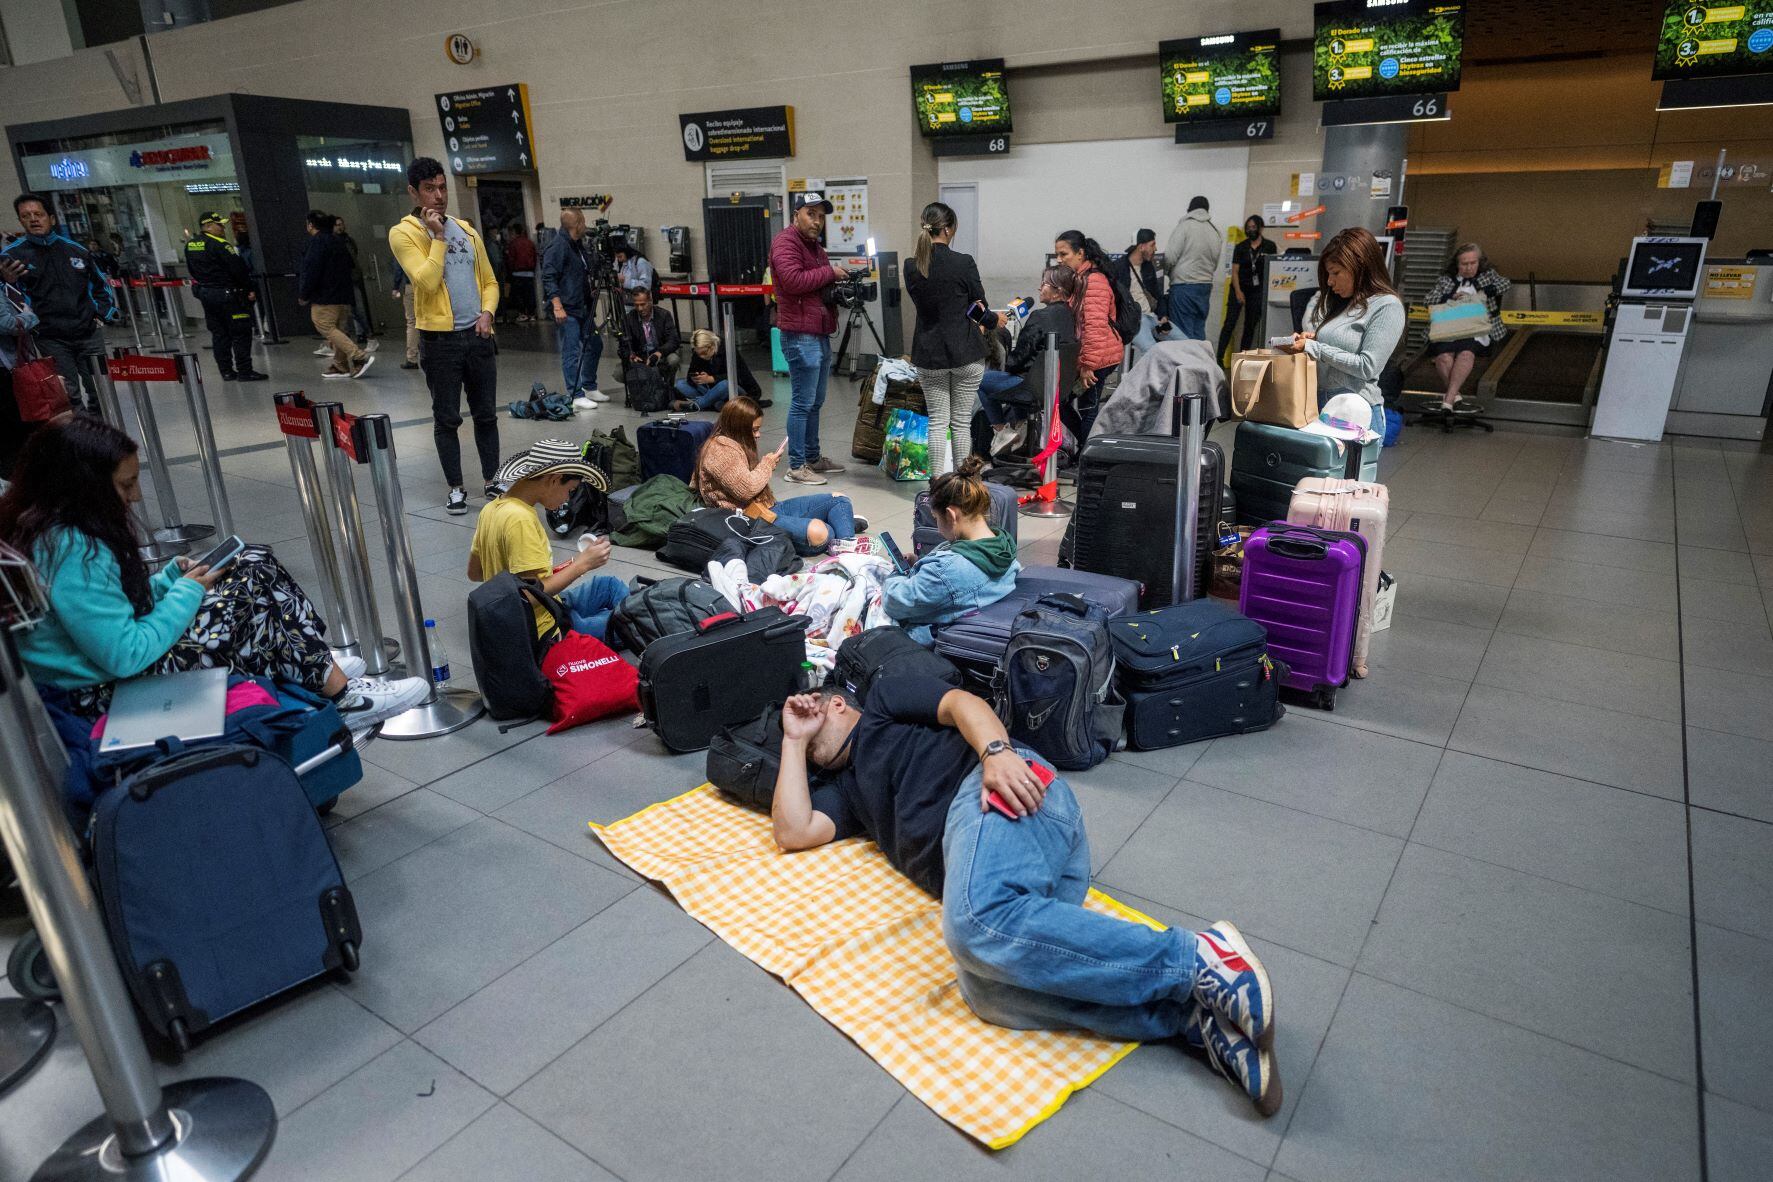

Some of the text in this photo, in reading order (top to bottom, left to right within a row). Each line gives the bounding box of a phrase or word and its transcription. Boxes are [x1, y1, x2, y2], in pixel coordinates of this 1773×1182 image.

[1338, 27, 1361, 35] Dorado
[1389, 42, 1407, 50] recibir
[1415, 39, 1439, 47] máxima
[1380, 47, 1413, 56] calificación
[943, 63, 968, 71] SAMSUNG
[1399, 67, 1441, 76] bioseguridad
[1412, 99, 1437, 116] 66
[706, 119, 743, 128] Recibo equipaje
[708, 124, 786, 136] sobredimensionado internacional
[1247, 122, 1267, 137] 67
[709, 134, 765, 144] Oversized international
[710, 143, 750, 154] baggage drop-off
[989, 138, 1005, 152] 68
[559, 194, 605, 207] MIGRACIÓN
[129, 365, 165, 374] Alemana
[570, 655, 619, 673] SIMONELLI
